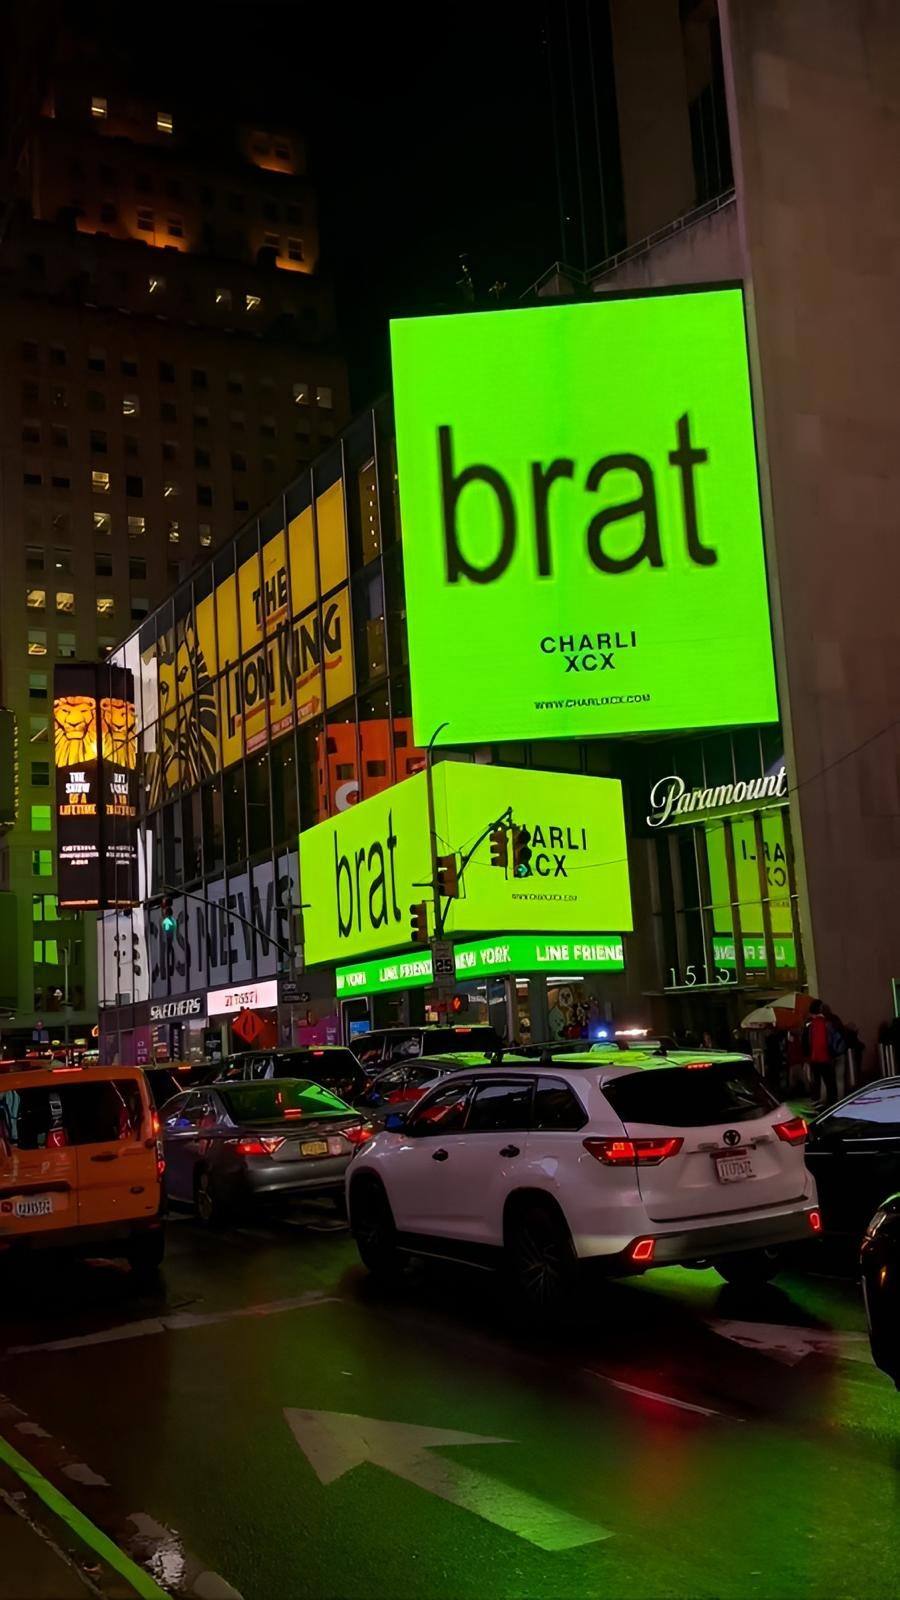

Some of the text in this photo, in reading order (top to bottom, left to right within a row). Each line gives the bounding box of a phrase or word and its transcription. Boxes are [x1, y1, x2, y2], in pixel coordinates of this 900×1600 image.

[436, 409, 718, 584] brat
[252, 566, 289, 626] THE
[224, 645, 276, 740] LION
[276, 602, 343, 708] KING
[540, 630, 637, 653] CHARLI
[564, 652, 616, 673] XCX
[646, 766, 788, 828] Paramount
[530, 824, 587, 850] ARLI
[333, 808, 403, 938] brat
[480, 944, 512, 965] YORK
[535, 943, 570, 962] LINE
